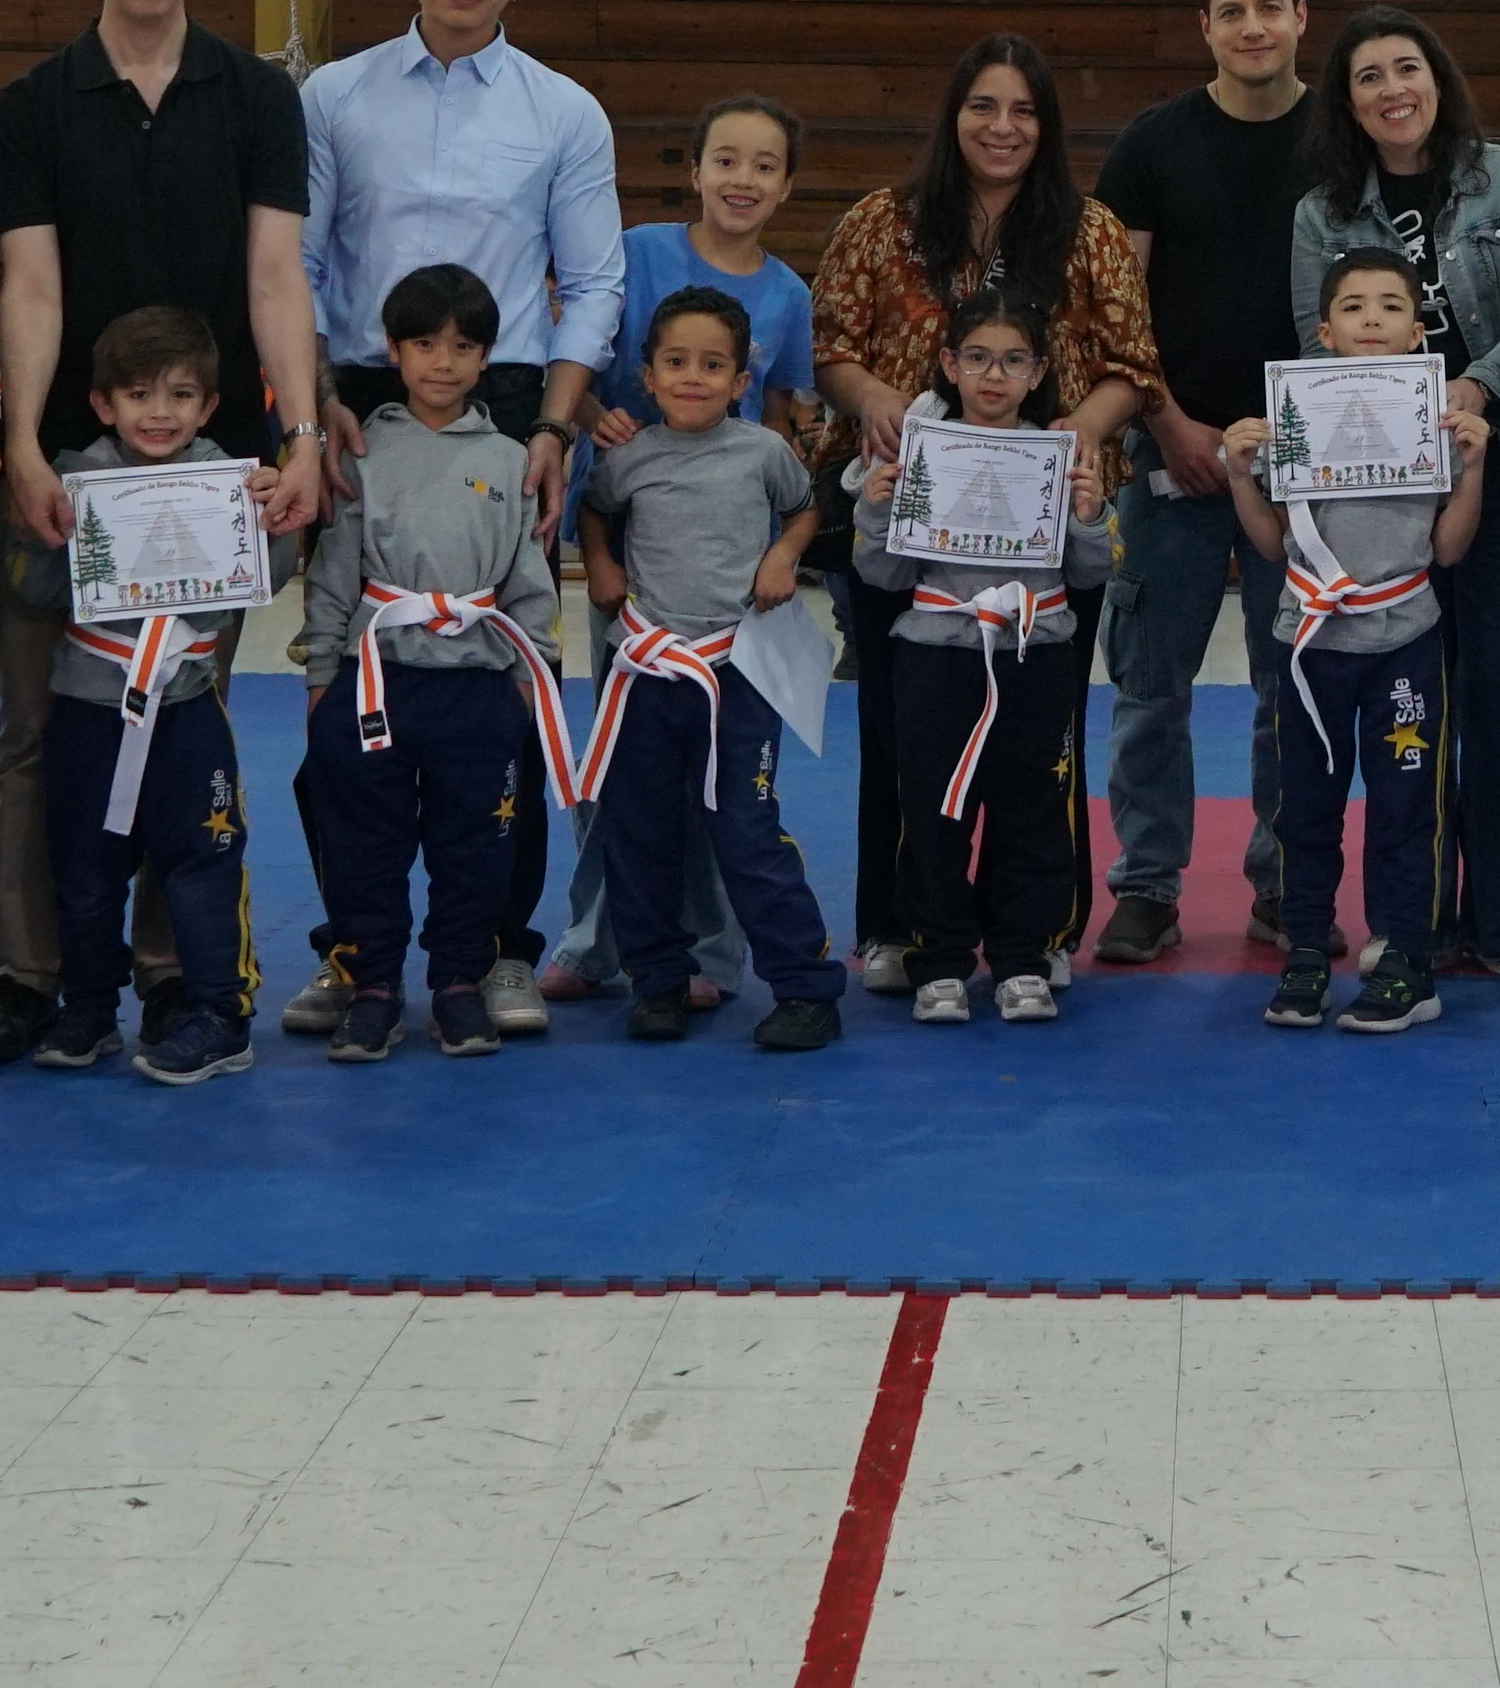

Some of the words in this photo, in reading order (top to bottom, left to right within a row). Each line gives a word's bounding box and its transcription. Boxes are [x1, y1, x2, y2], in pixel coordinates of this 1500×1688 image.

[1390, 678, 1415, 722] Salle
[1414, 693, 1425, 720] CHILE
[1401, 748, 1421, 770] La
[211, 770, 225, 806] Salle
[758, 787, 767, 800] La
[217, 833, 231, 852] La
